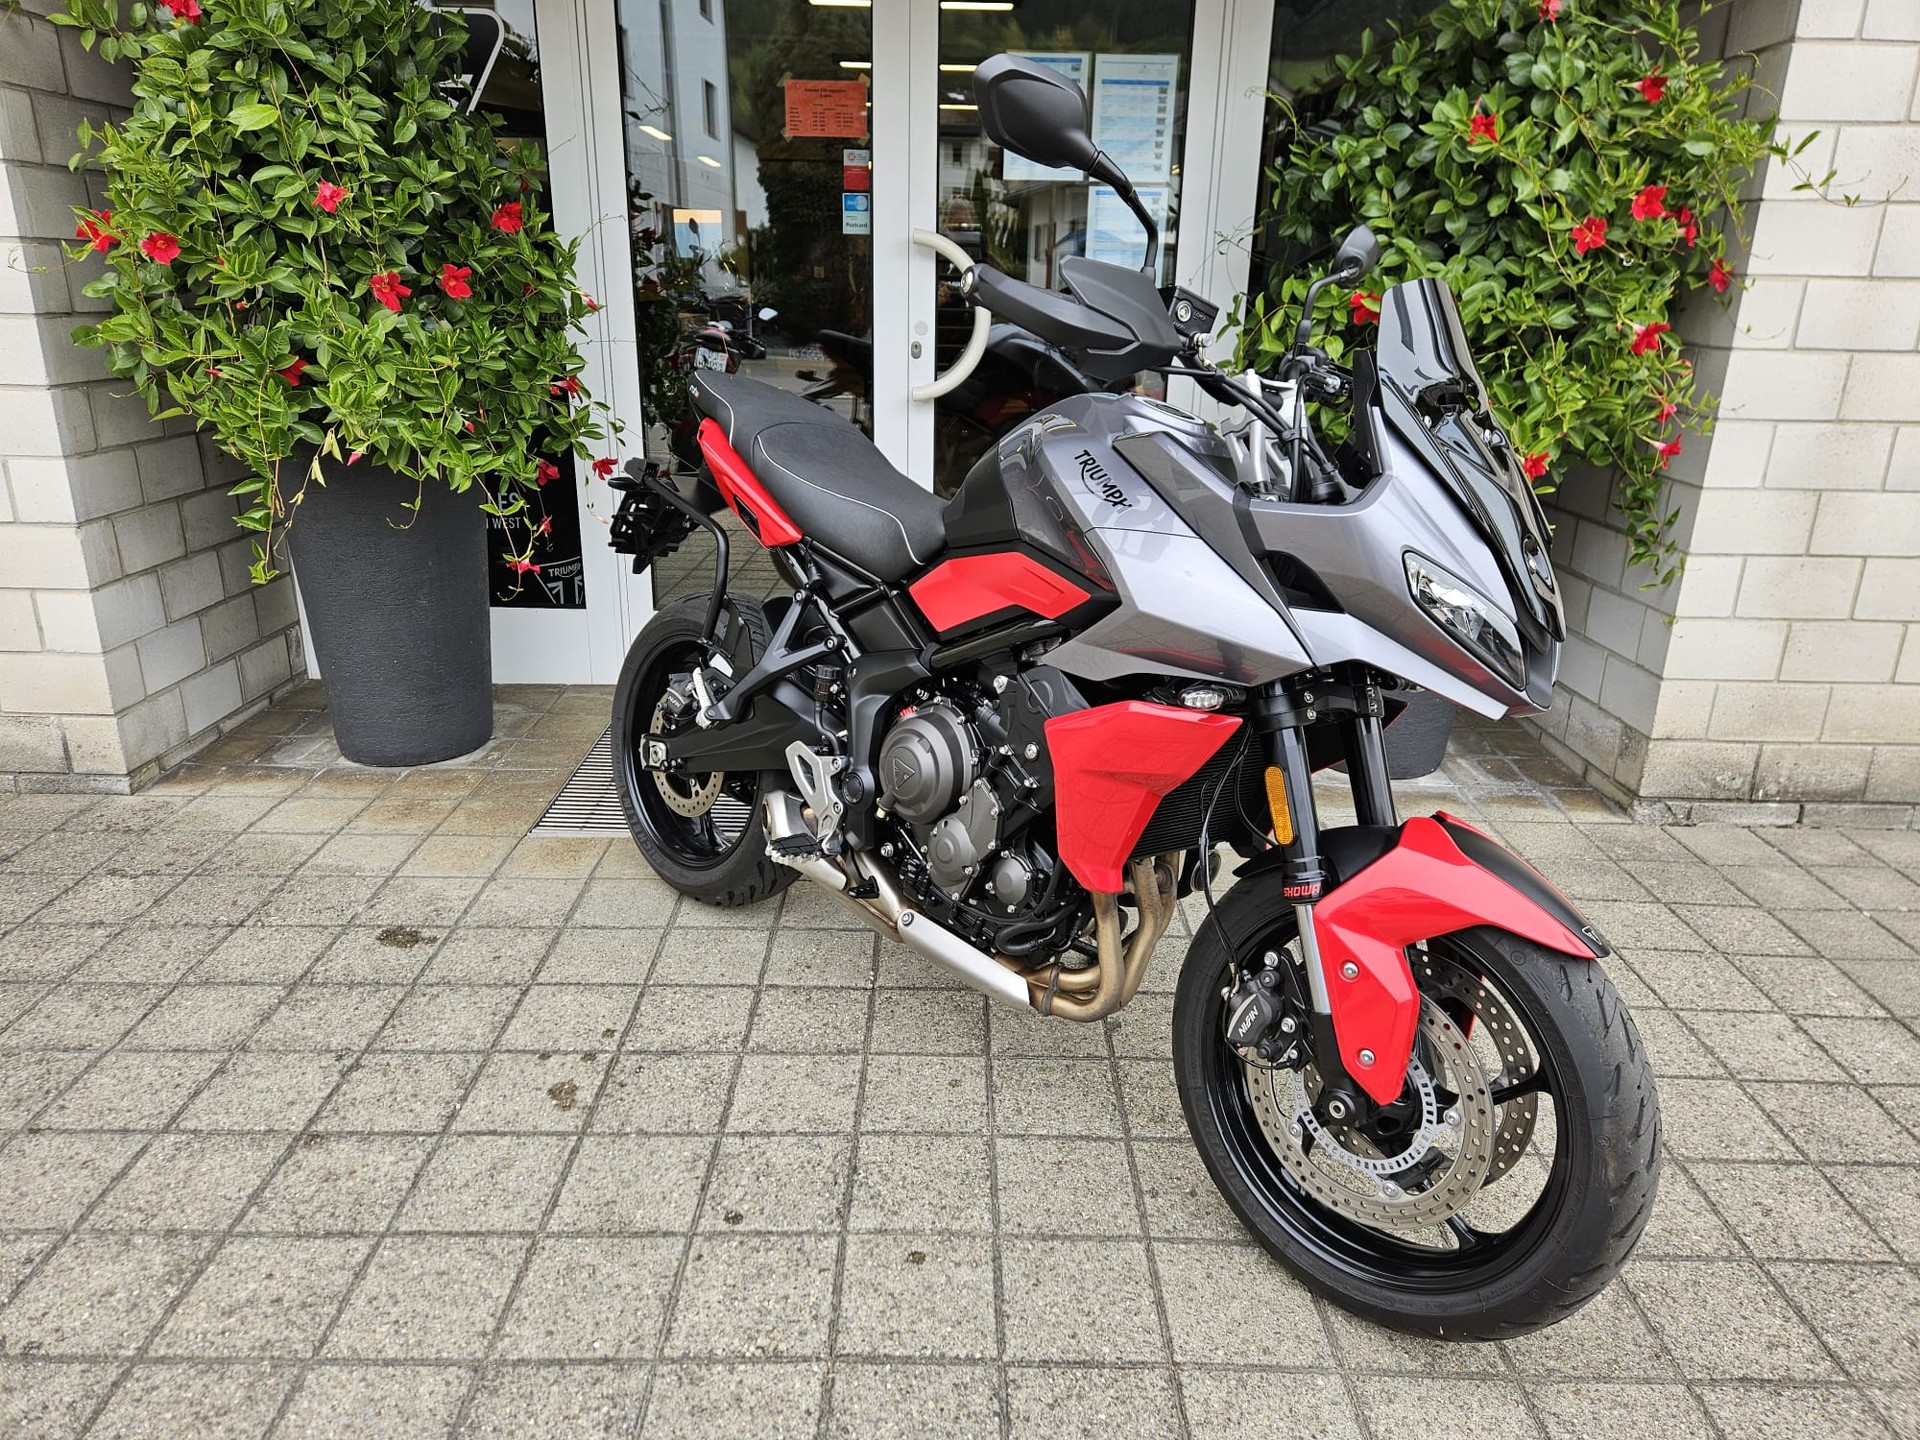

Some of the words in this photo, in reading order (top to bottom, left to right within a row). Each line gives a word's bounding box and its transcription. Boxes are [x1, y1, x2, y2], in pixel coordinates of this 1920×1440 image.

[845, 221, 868, 229] Postcard
[1074, 449, 1133, 514] TRIUMPH
[1283, 882, 1321, 897] SHOWA
